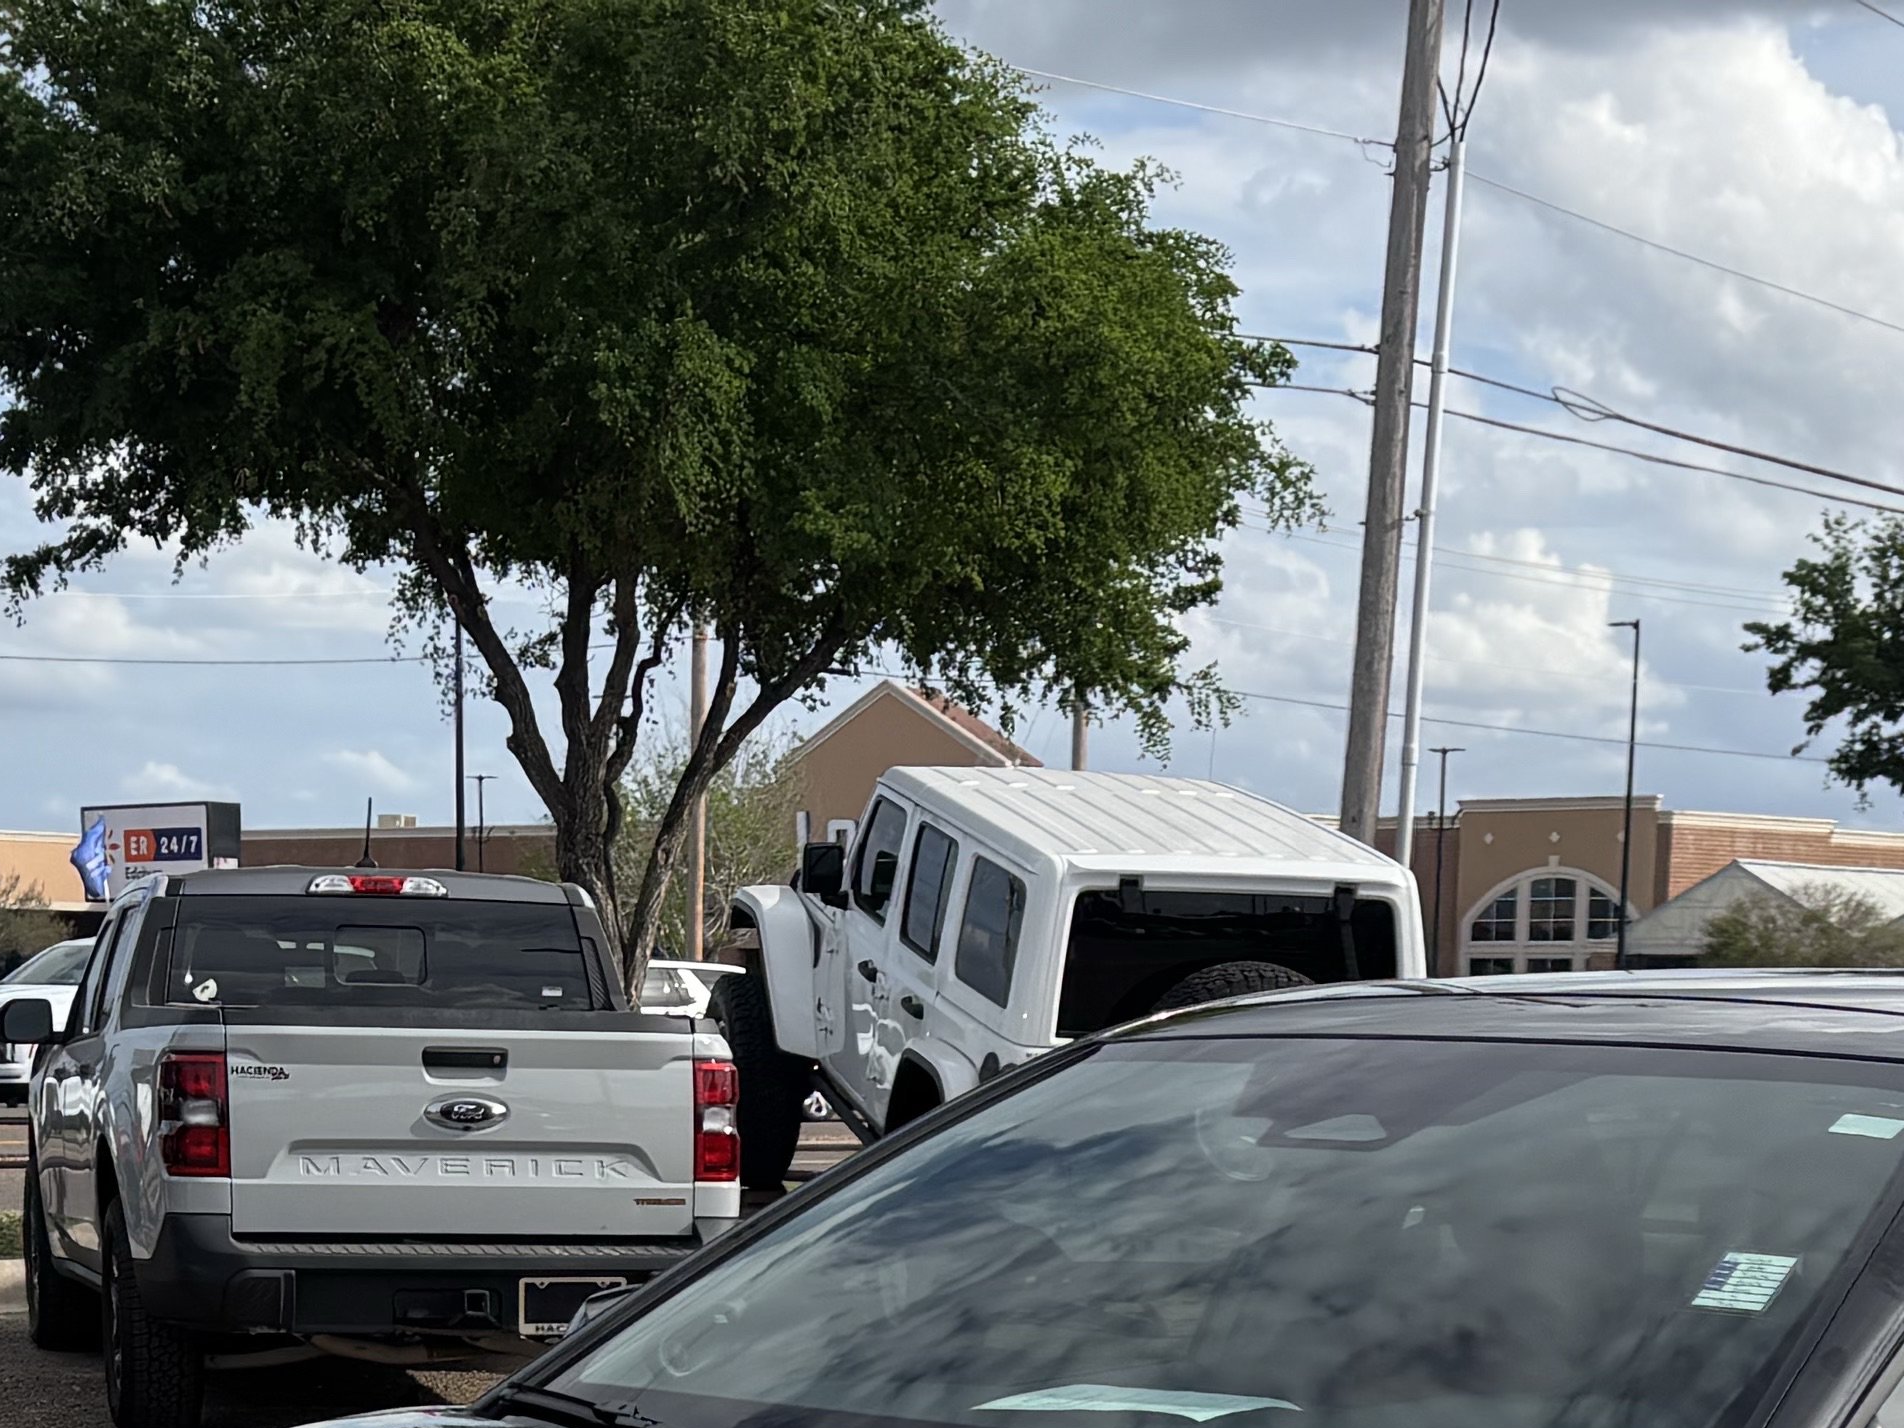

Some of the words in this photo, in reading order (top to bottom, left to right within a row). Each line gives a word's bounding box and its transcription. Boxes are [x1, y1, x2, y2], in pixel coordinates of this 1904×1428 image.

[130, 836, 149, 856] ER
[159, 835, 198, 854] 24/7
[230, 1065, 286, 1077] HACIENDA
[299, 1156, 629, 1179] MAVERICK
